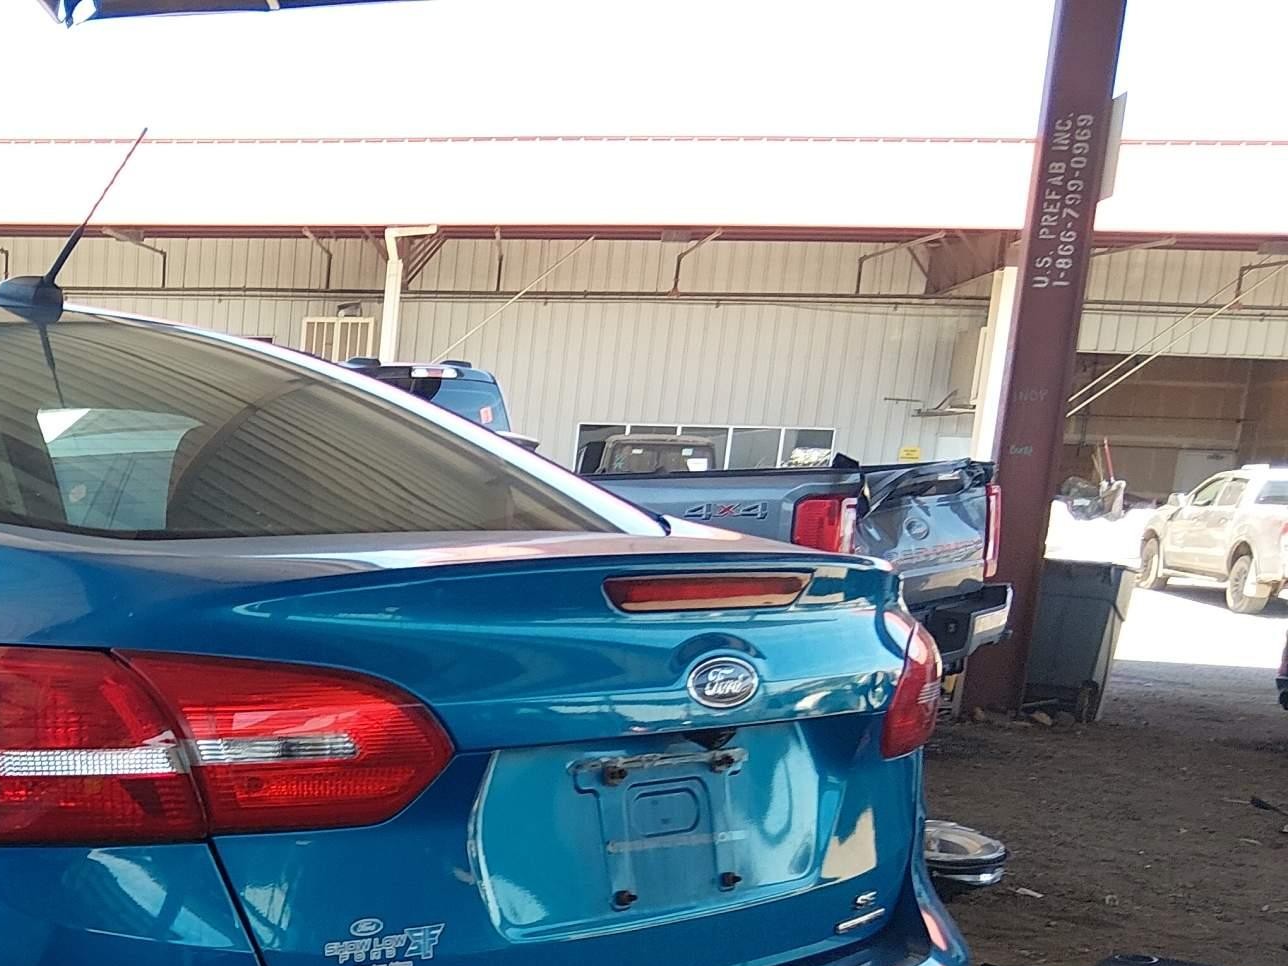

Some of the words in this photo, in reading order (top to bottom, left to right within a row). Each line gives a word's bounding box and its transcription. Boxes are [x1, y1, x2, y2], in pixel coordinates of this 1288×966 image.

[1052, 112, 1075, 151] INC.
[1039, 161, 1066, 239] PREFAB
[1053, 114, 1094, 286] 1-866-799-0969
[1033, 250, 1055, 288] U.S.
[704, 667, 749, 696] Ford
[324, 938, 372, 957] SHOW
[373, 933, 408, 952] LOW
[338, 947, 397, 964] FORD
